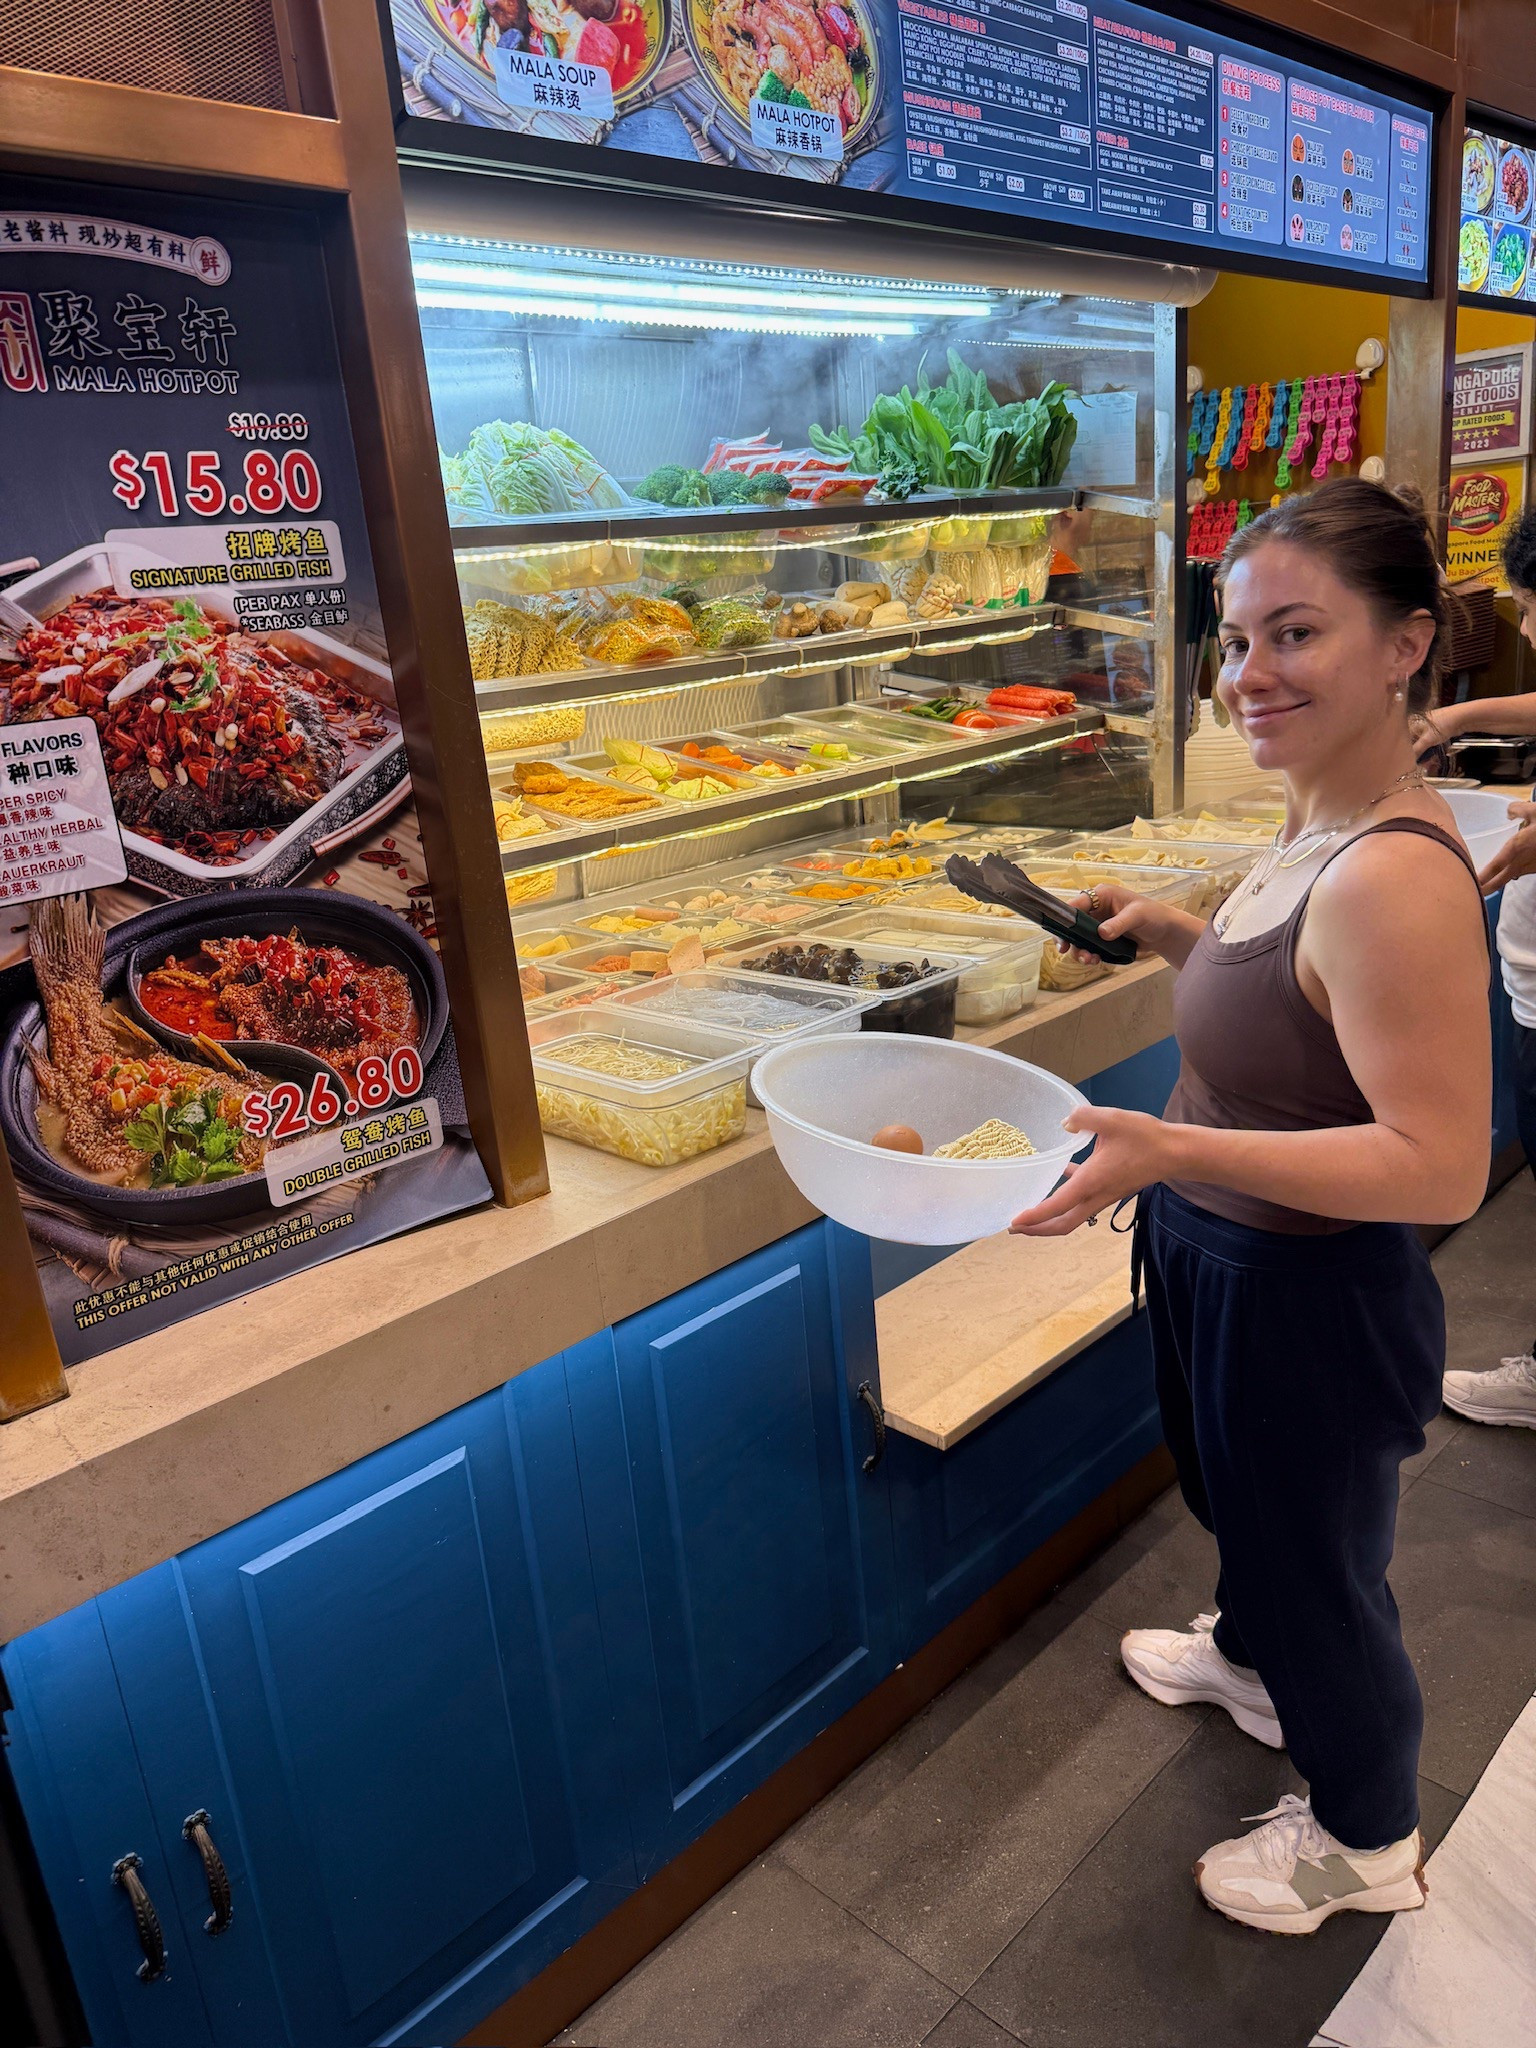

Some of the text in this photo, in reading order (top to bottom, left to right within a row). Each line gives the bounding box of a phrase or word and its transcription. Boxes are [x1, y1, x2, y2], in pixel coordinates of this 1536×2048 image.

[509, 55, 597, 88] MALA SOUP
[1222, 60, 1281, 93] DINING PROCESS
[533, 82, 582, 112] 麻辣烫
[1291, 83, 1318, 105] CHOOSE
[1318, 92, 1330, 109] POT
[1331, 97, 1347, 114] BASE
[756, 105, 836, 134] MALA HOTPOT
[775, 127, 822, 153] 麻辣香锅
[938, 165, 954, 176] $1.00
[1008, 178, 1023, 190] $2.00
[1070, 190, 1083, 200] $3.00
[198, 250, 221, 277] 鲜
[39, 290, 238, 366] 聚宝轩
[53, 365, 240, 396] MALA HOTPOT
[1474, 384, 1516, 403] FOODS
[1460, 404, 1494, 416] ENJOY
[1462, 417, 1483, 426] RATED
[1484, 413, 1505, 423] FOODS
[228, 412, 309, 442] $19.80
[1464, 439, 1489, 450] 2023
[109, 449, 322, 518] $15.80
[1448, 492, 1501, 516] MASTERS
[226, 528, 329, 560] 招牌烤鱼
[130, 558, 332, 589] SIGNATURE GRILLED FISH
[234, 595, 267, 615] (PER
[270, 594, 302, 611] PAX
[1, 732, 83, 758] FLAVORS
[7, 754, 79, 785] 种口味
[26, 788, 66, 805] SPICY
[0, 817, 103, 846] ALTHY HERBAL
[0, 854, 85, 882] AUERKRAUT
[242, 1046, 424, 1139] $26.80
[341, 1107, 428, 1153] 鸳鸯烤鱼
[284, 1130, 432, 1197] DOUBLE GRILLED FISH
[76, 1212, 354, 1330] THIS OFFER NOT VALID WITH ANY OTHER OFFER
